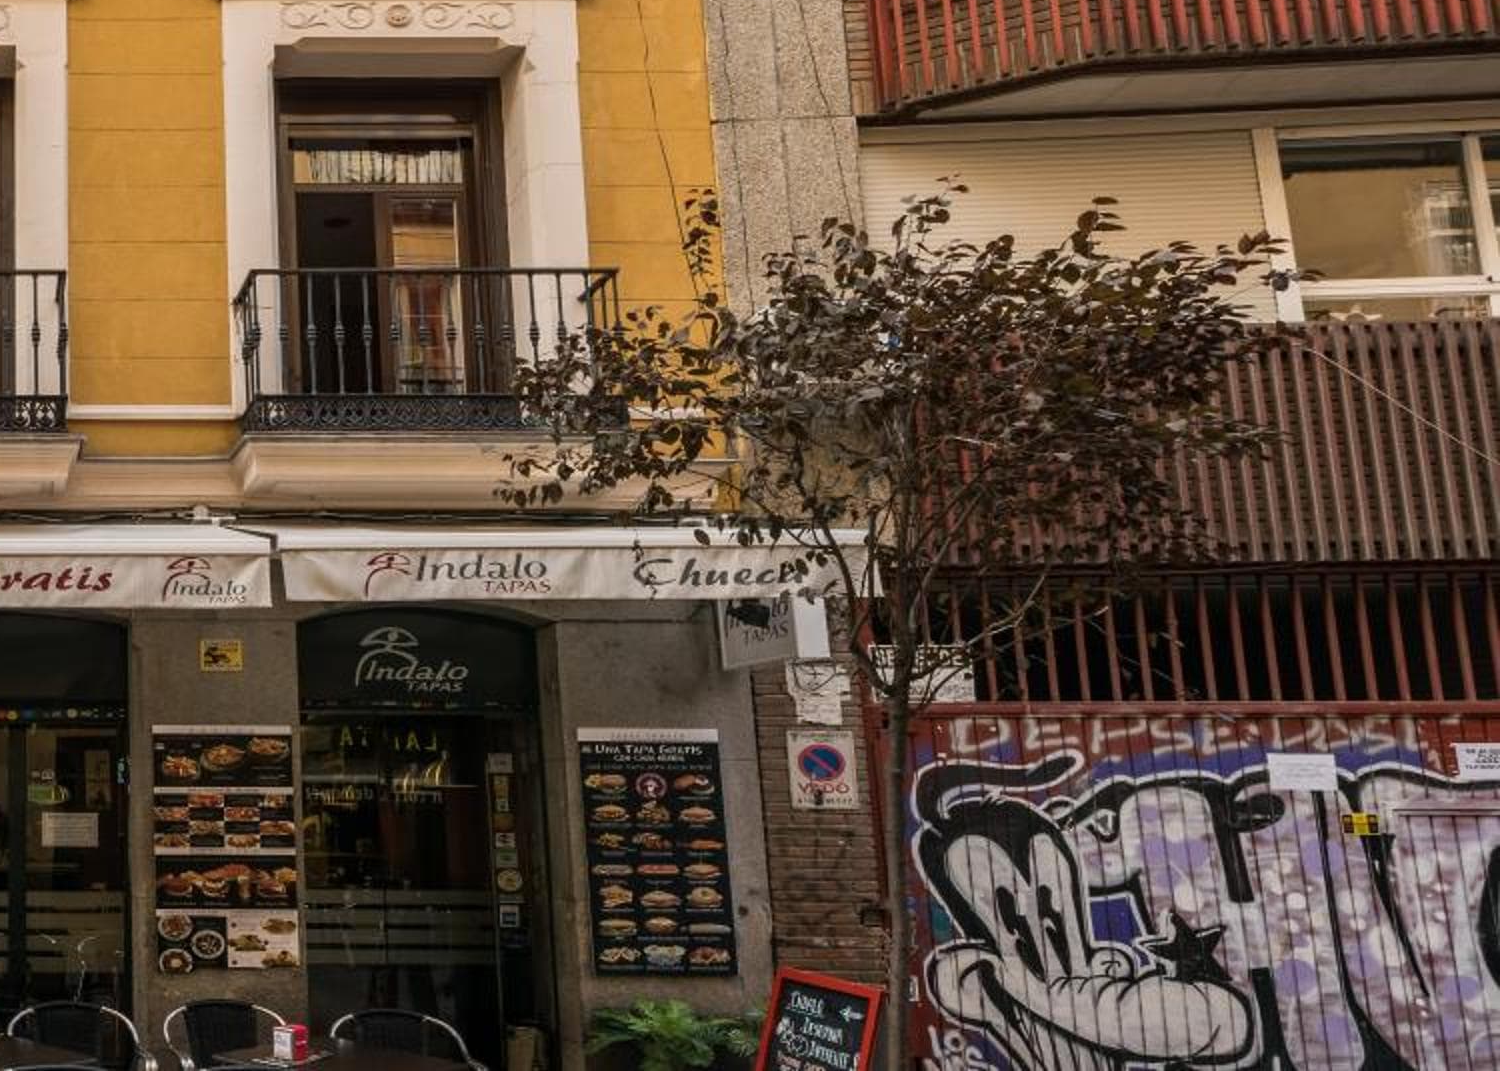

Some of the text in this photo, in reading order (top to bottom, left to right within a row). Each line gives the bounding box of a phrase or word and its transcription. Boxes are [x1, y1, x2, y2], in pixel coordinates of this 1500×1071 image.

[416, 552, 548, 581] Indalo
[172, 579, 247, 596] Indalo
[484, 580, 552, 594] TAPAS
[364, 660, 469, 681] Indalo
[406, 680, 464, 693] TAPAS
